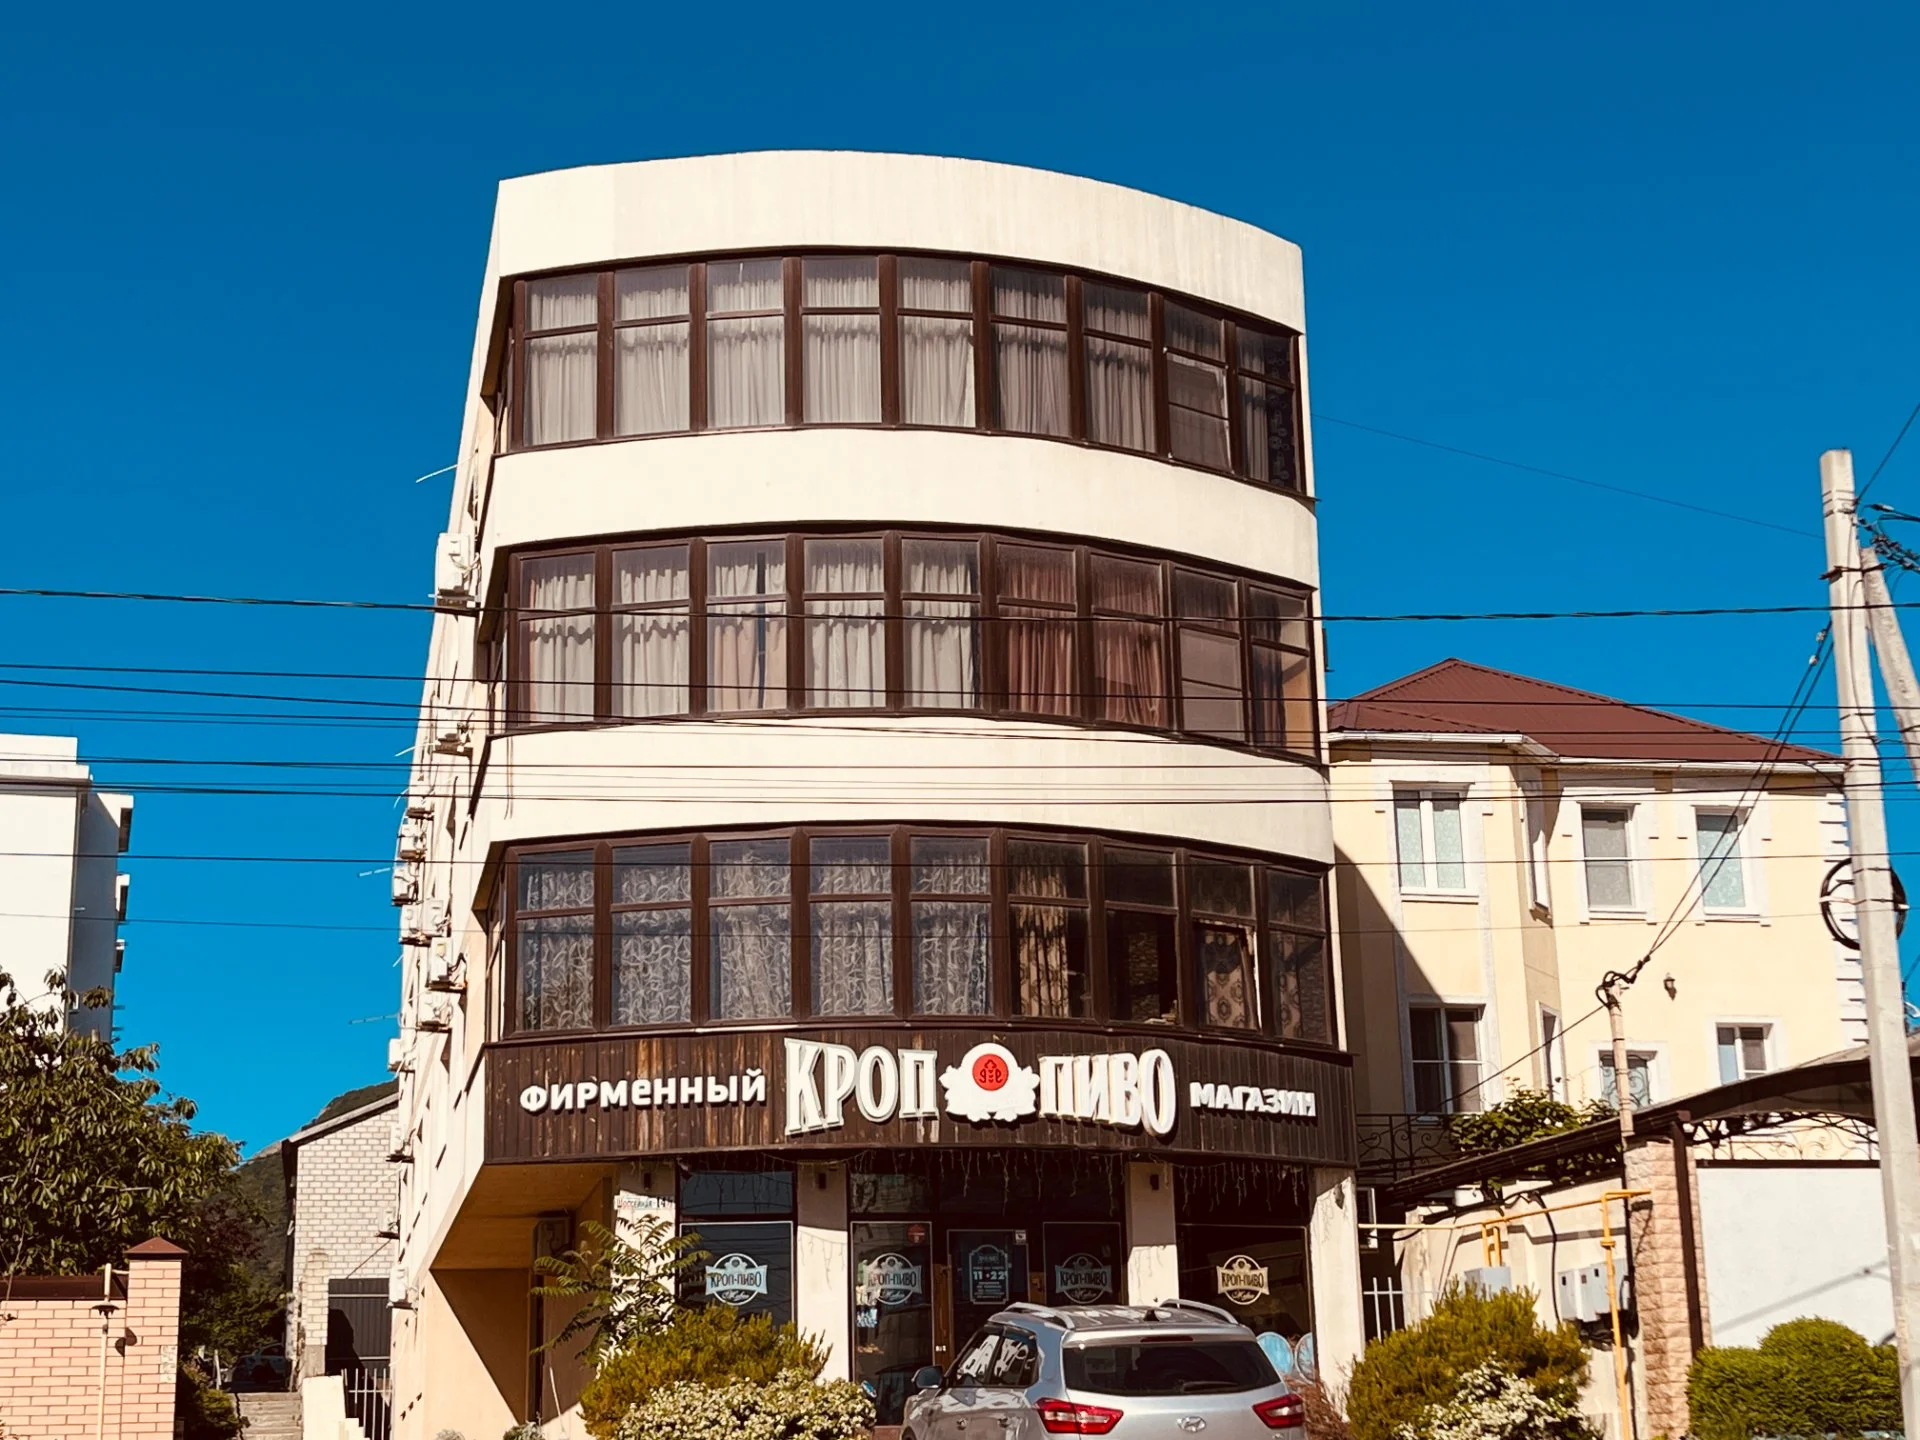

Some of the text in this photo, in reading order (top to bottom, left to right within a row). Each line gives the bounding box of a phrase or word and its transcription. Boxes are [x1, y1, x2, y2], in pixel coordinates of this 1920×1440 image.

[784, 1037, 939, 1136] КРОП
[1037, 1048, 1177, 1136] ПИВО
[1189, 1081, 1317, 1117] МАГАЗИН
[710, 1271, 763, 1289] КРОП-ПИВО
[866, 1270, 917, 1289] КРОП-ПИВО
[1059, 1269, 1108, 1288] КРОП-ПИВО
[1220, 1271, 1265, 1289] КРОП-ПИВО
